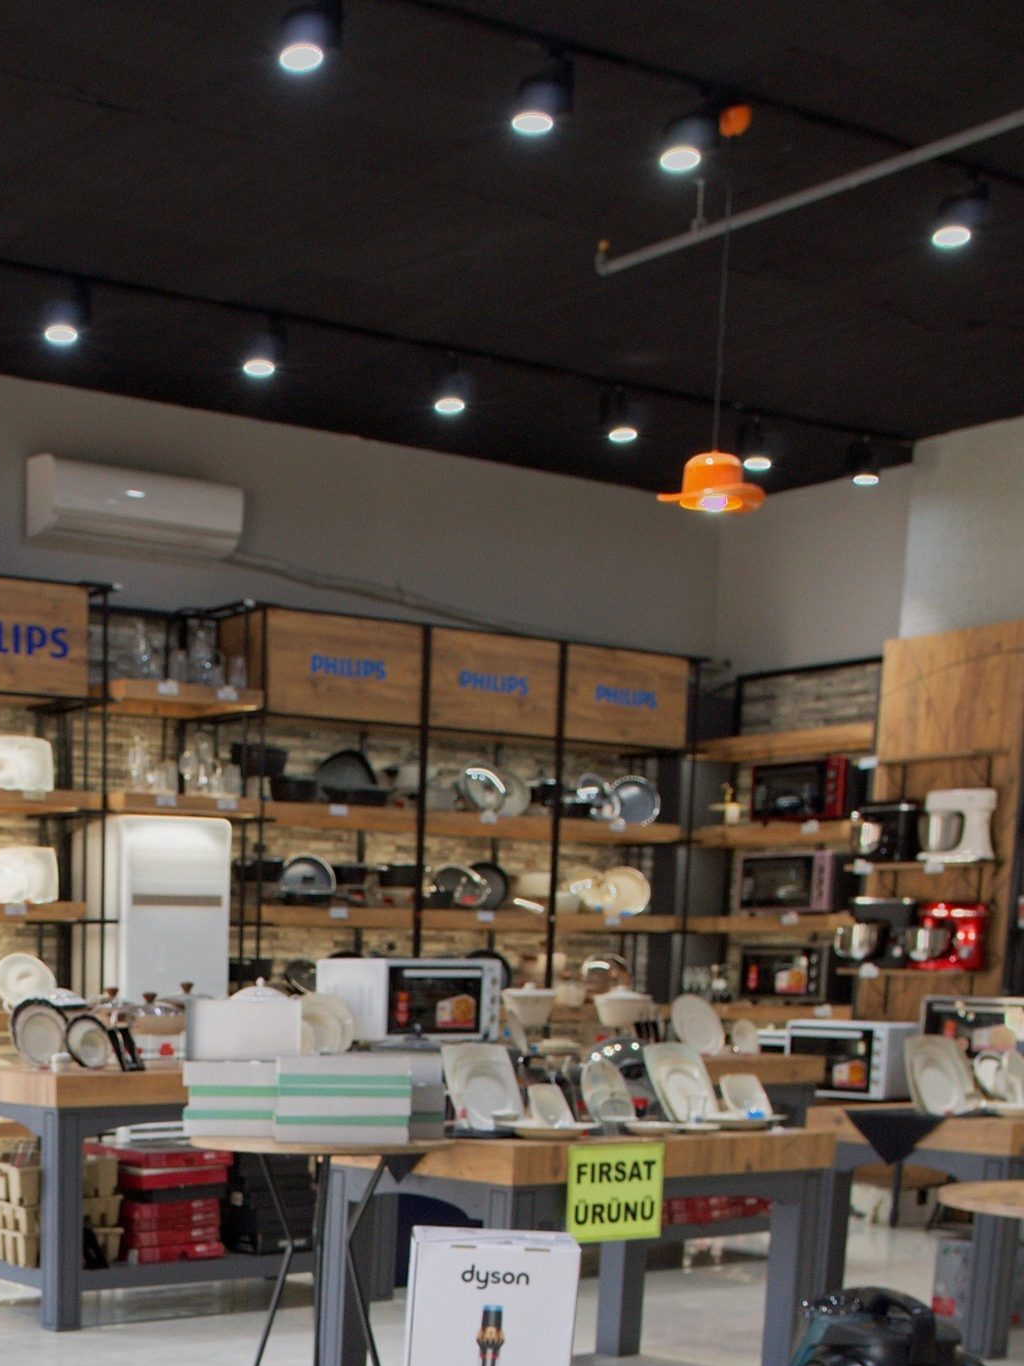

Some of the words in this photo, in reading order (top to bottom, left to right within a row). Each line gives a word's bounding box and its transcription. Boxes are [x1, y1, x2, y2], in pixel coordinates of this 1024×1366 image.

[310, 654, 387, 681] PHILIPS
[459, 670, 529, 697] PHILIPS
[595, 684, 658, 709] PHILIPS
[576, 1160, 657, 1184] FIRSAT
[574, 1196, 655, 1226] ÜRÜNÜ
[461, 1264, 530, 1290] dyson
